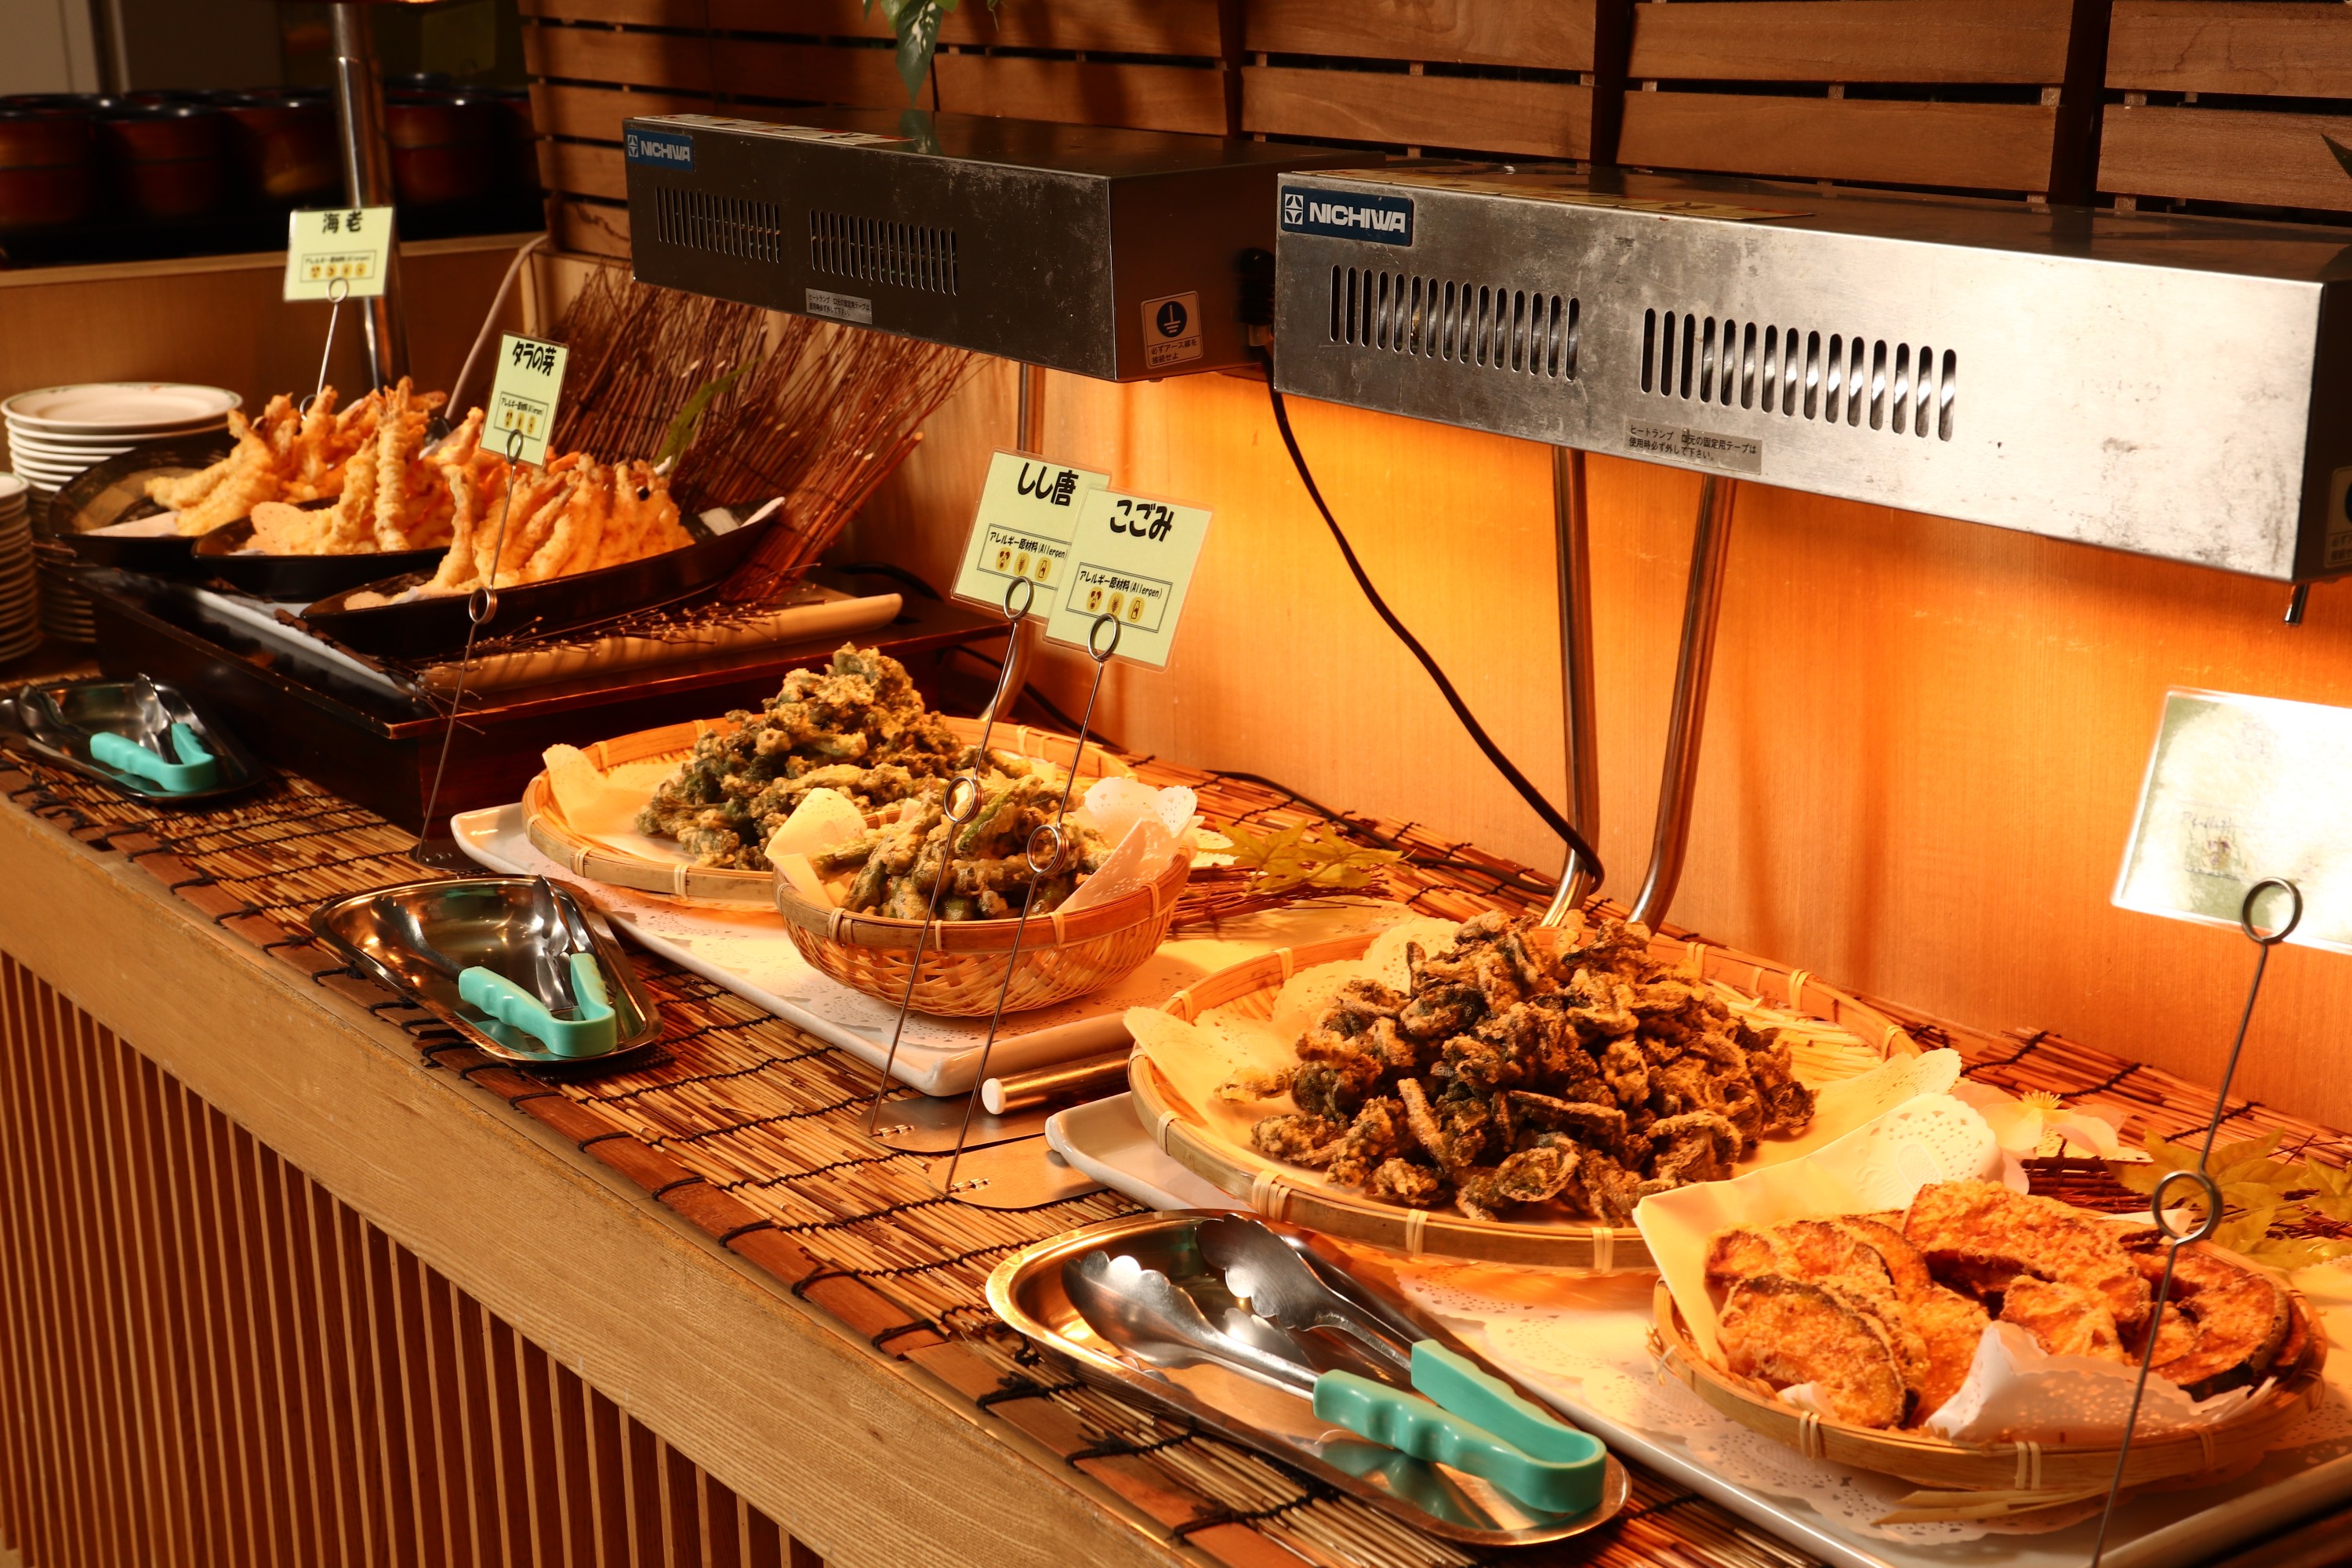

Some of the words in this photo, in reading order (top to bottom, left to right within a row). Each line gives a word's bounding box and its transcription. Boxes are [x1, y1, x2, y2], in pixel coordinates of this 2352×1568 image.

[641, 140, 691, 162] NICHIWA
[322, 210, 363, 234] 海老
[1309, 201, 1406, 234] NICHIWA
[512, 340, 557, 376] タラの芽
[1630, 425, 1675, 441] ヒートランプ
[1017, 462, 1080, 507] しし唐
[1109, 499, 1175, 543] こごみ
